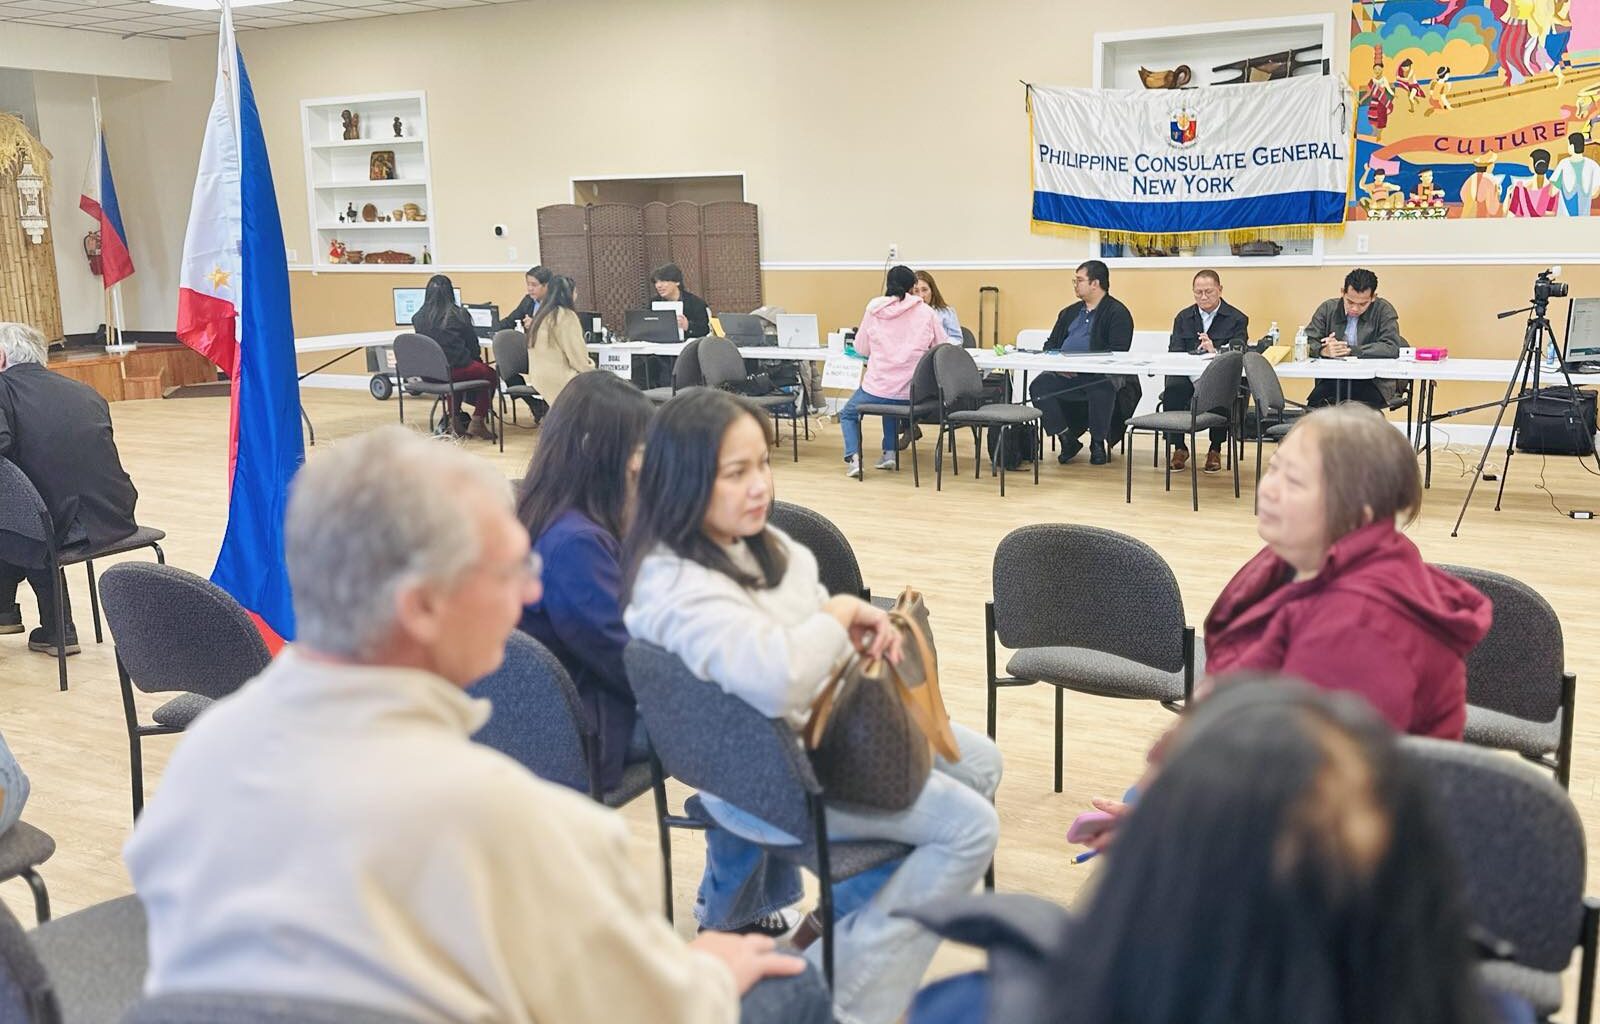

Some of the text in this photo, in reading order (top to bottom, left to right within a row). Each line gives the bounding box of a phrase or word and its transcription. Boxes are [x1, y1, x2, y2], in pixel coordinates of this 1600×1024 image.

[1434, 122, 1566, 155] CULTURE
[1039, 142, 1344, 173] PHILIPPINE CONSULATE GENERAL
[1133, 174, 1235, 195] NEW YORK
